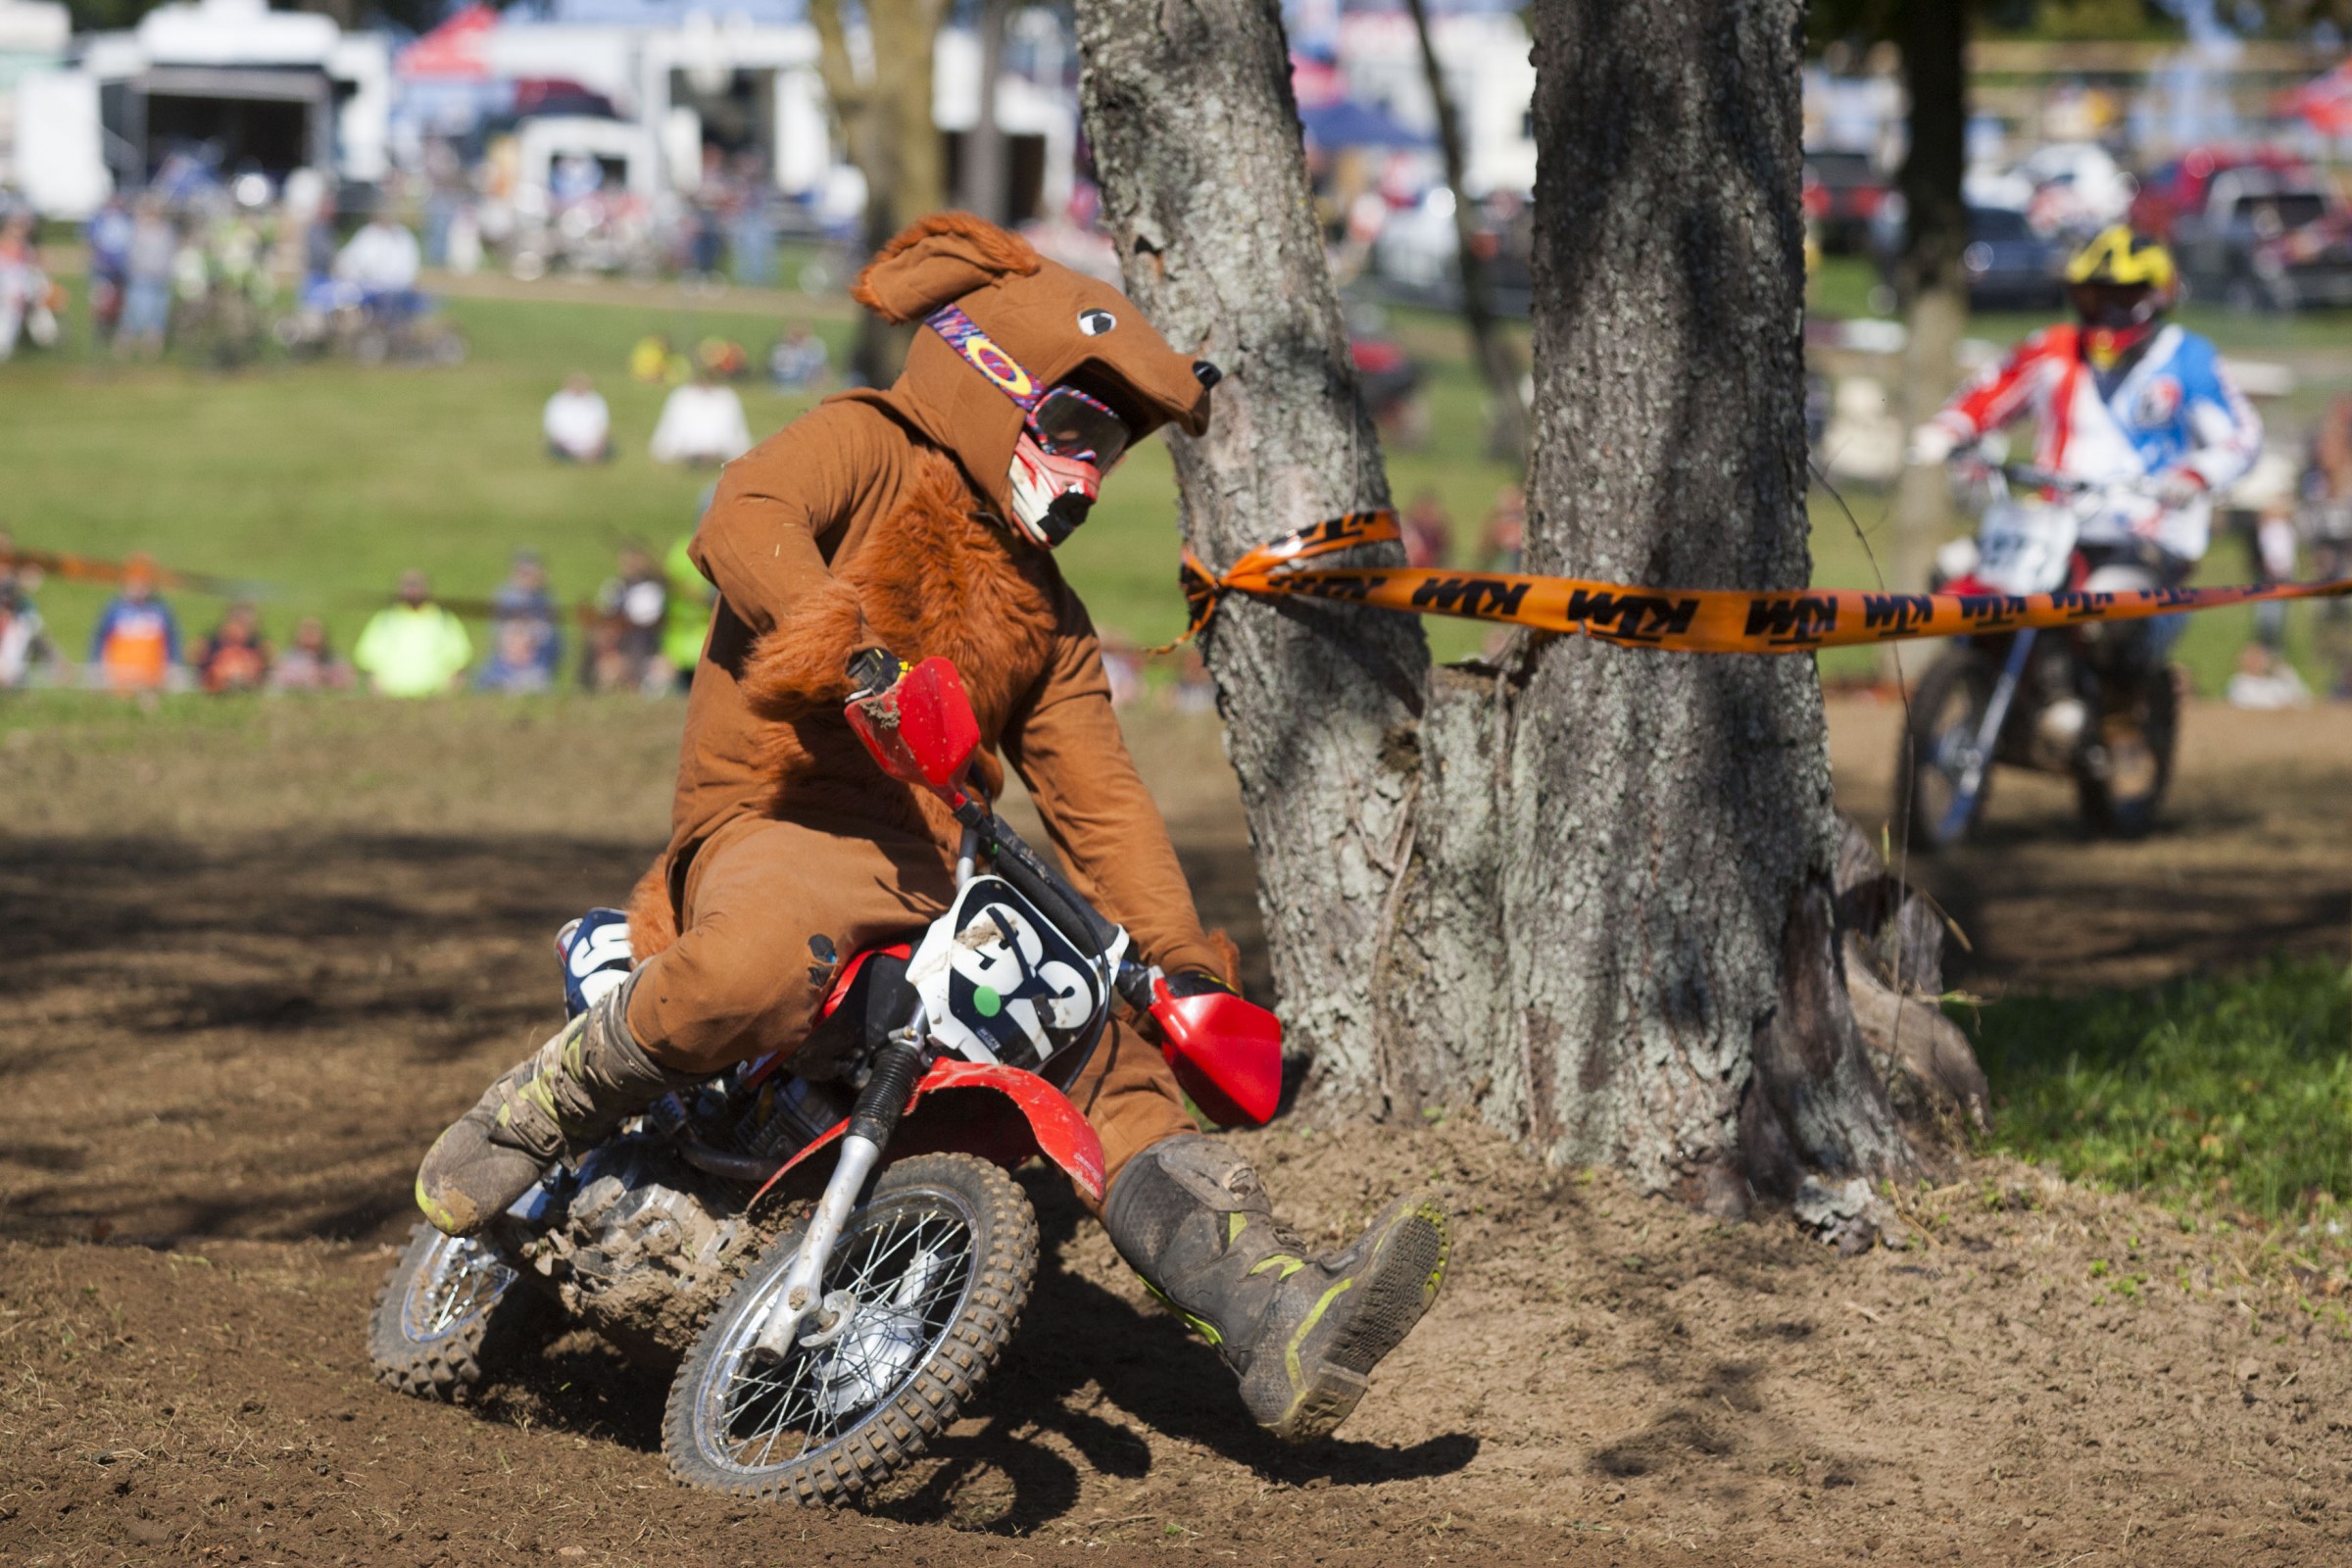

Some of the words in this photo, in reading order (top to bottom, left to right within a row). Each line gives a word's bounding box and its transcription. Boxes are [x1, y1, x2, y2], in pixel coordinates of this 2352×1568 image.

[1567, 589, 1701, 643] KTM
[1744, 596, 1838, 646] KTM
[1864, 594, 1934, 637] KTM
